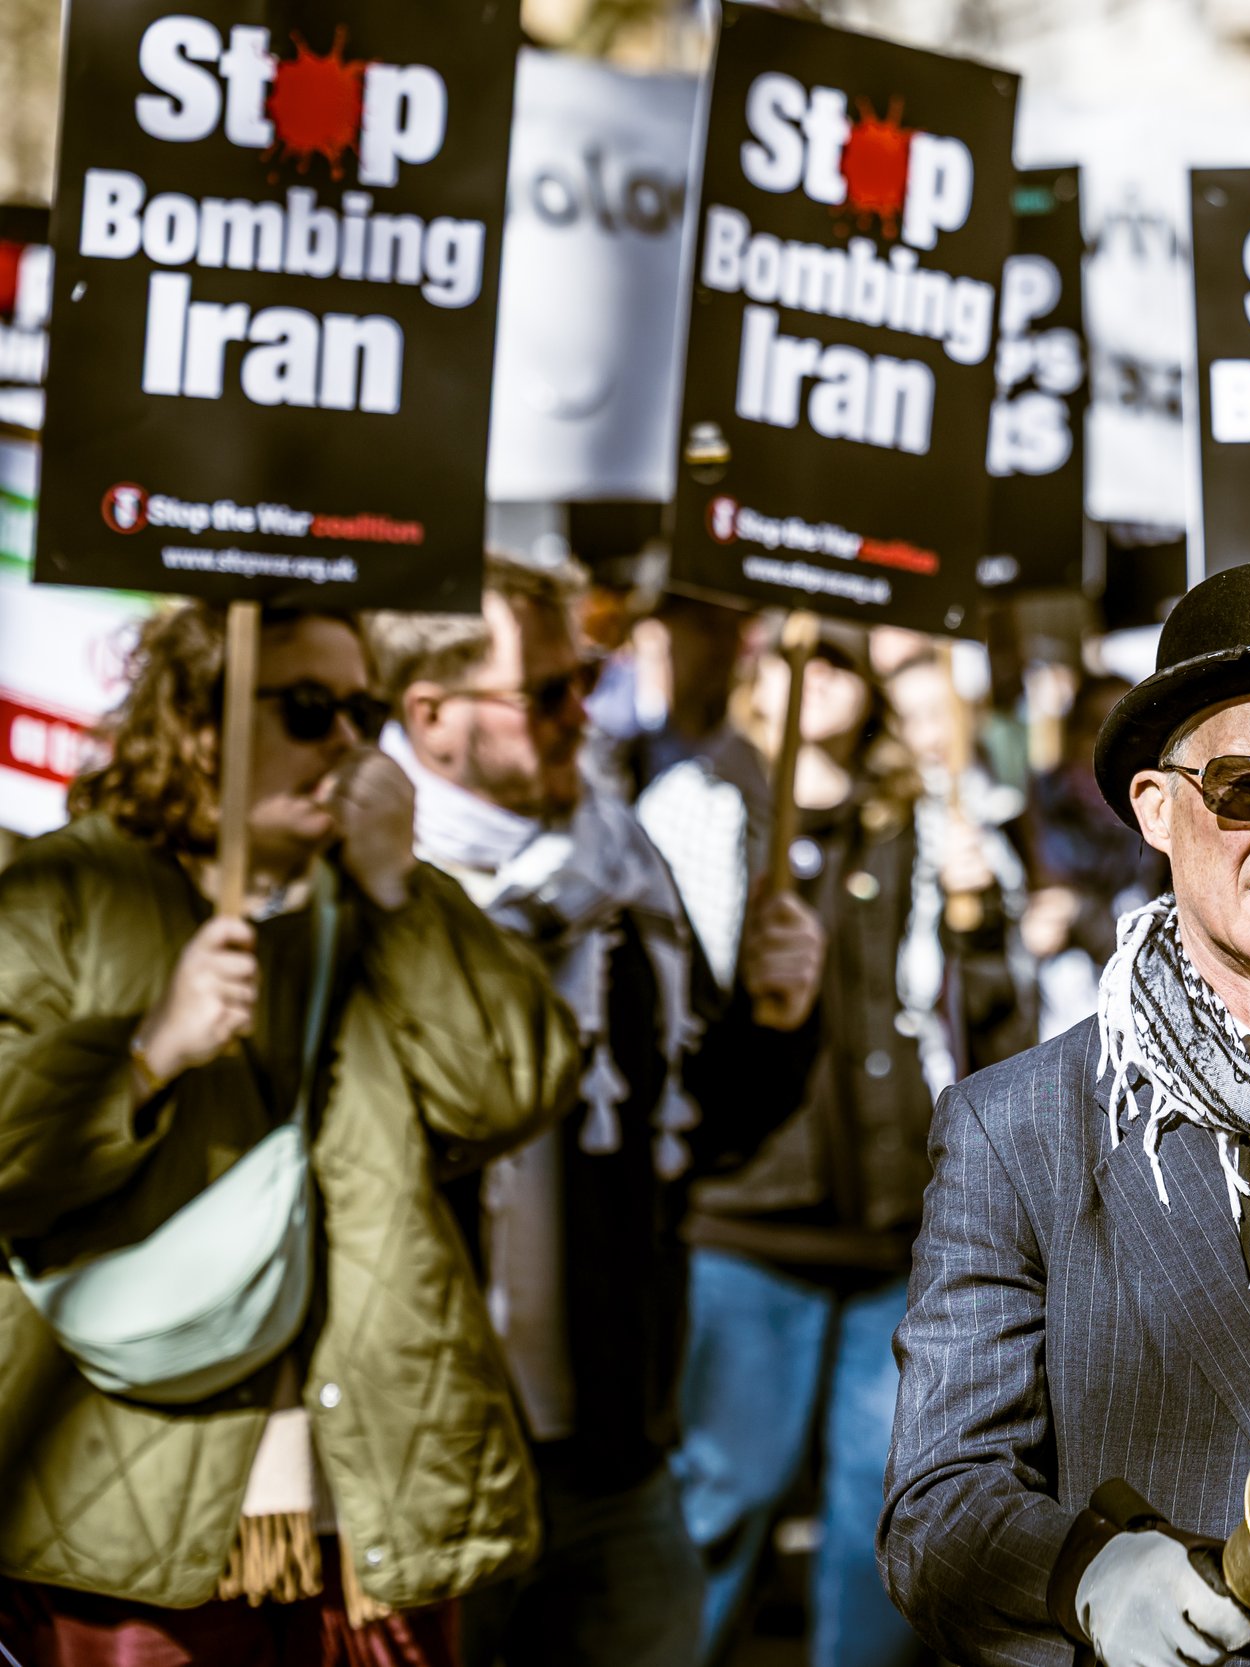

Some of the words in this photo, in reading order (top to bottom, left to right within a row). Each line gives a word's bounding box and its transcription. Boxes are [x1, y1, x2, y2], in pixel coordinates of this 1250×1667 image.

[136, 15, 447, 187] Stop
[741, 71, 974, 250] Stop
[80, 168, 486, 308] Bombing
[700, 204, 995, 365] Bombing
[142, 272, 404, 414] Iran
[736, 306, 935, 455] Iran
